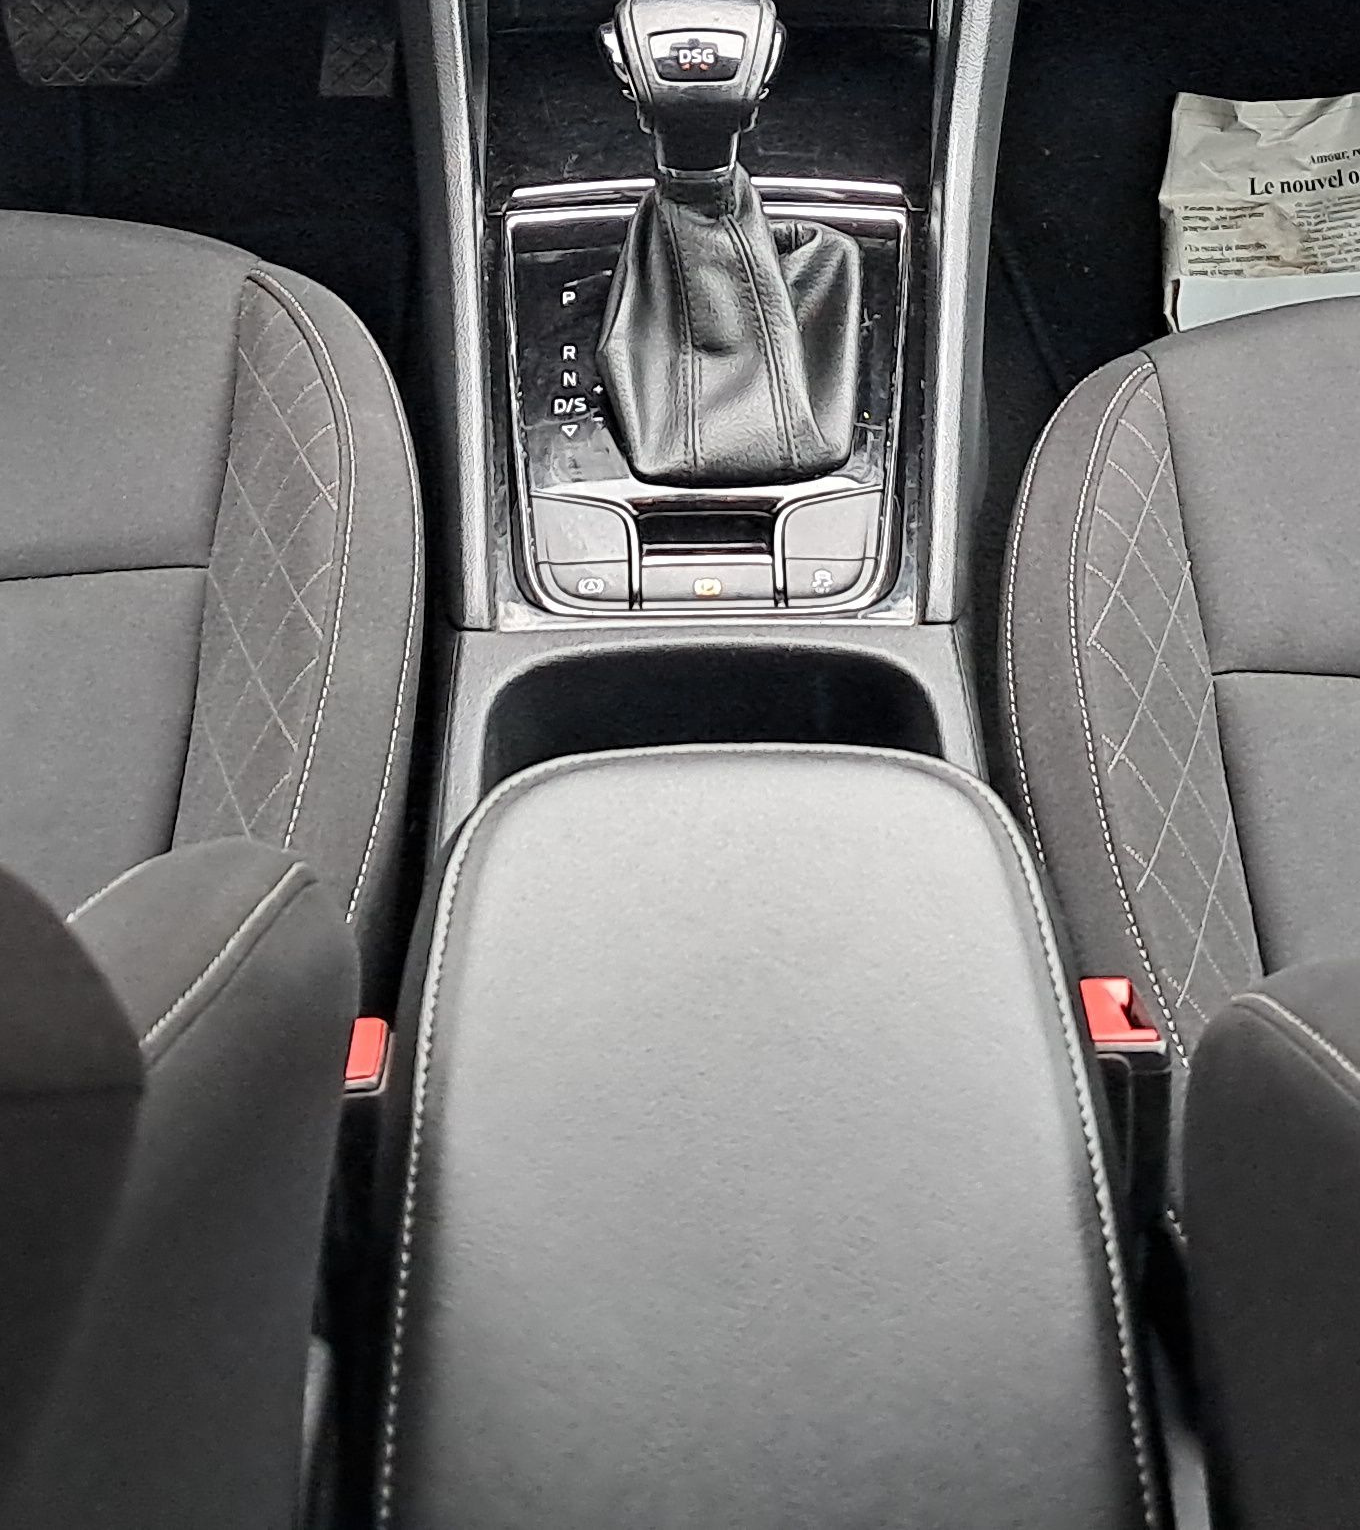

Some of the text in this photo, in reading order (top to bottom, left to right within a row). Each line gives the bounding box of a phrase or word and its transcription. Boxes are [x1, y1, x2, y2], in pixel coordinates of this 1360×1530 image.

[678, 48, 715, 64] DSG
[1248, 176, 1276, 196] Le
[1279, 169, 1343, 194] nouvel
[562, 291, 576, 305] P
[562, 345, 576, 361] R
[563, 372, 577, 387] N
[554, 397, 587, 415] D/S
